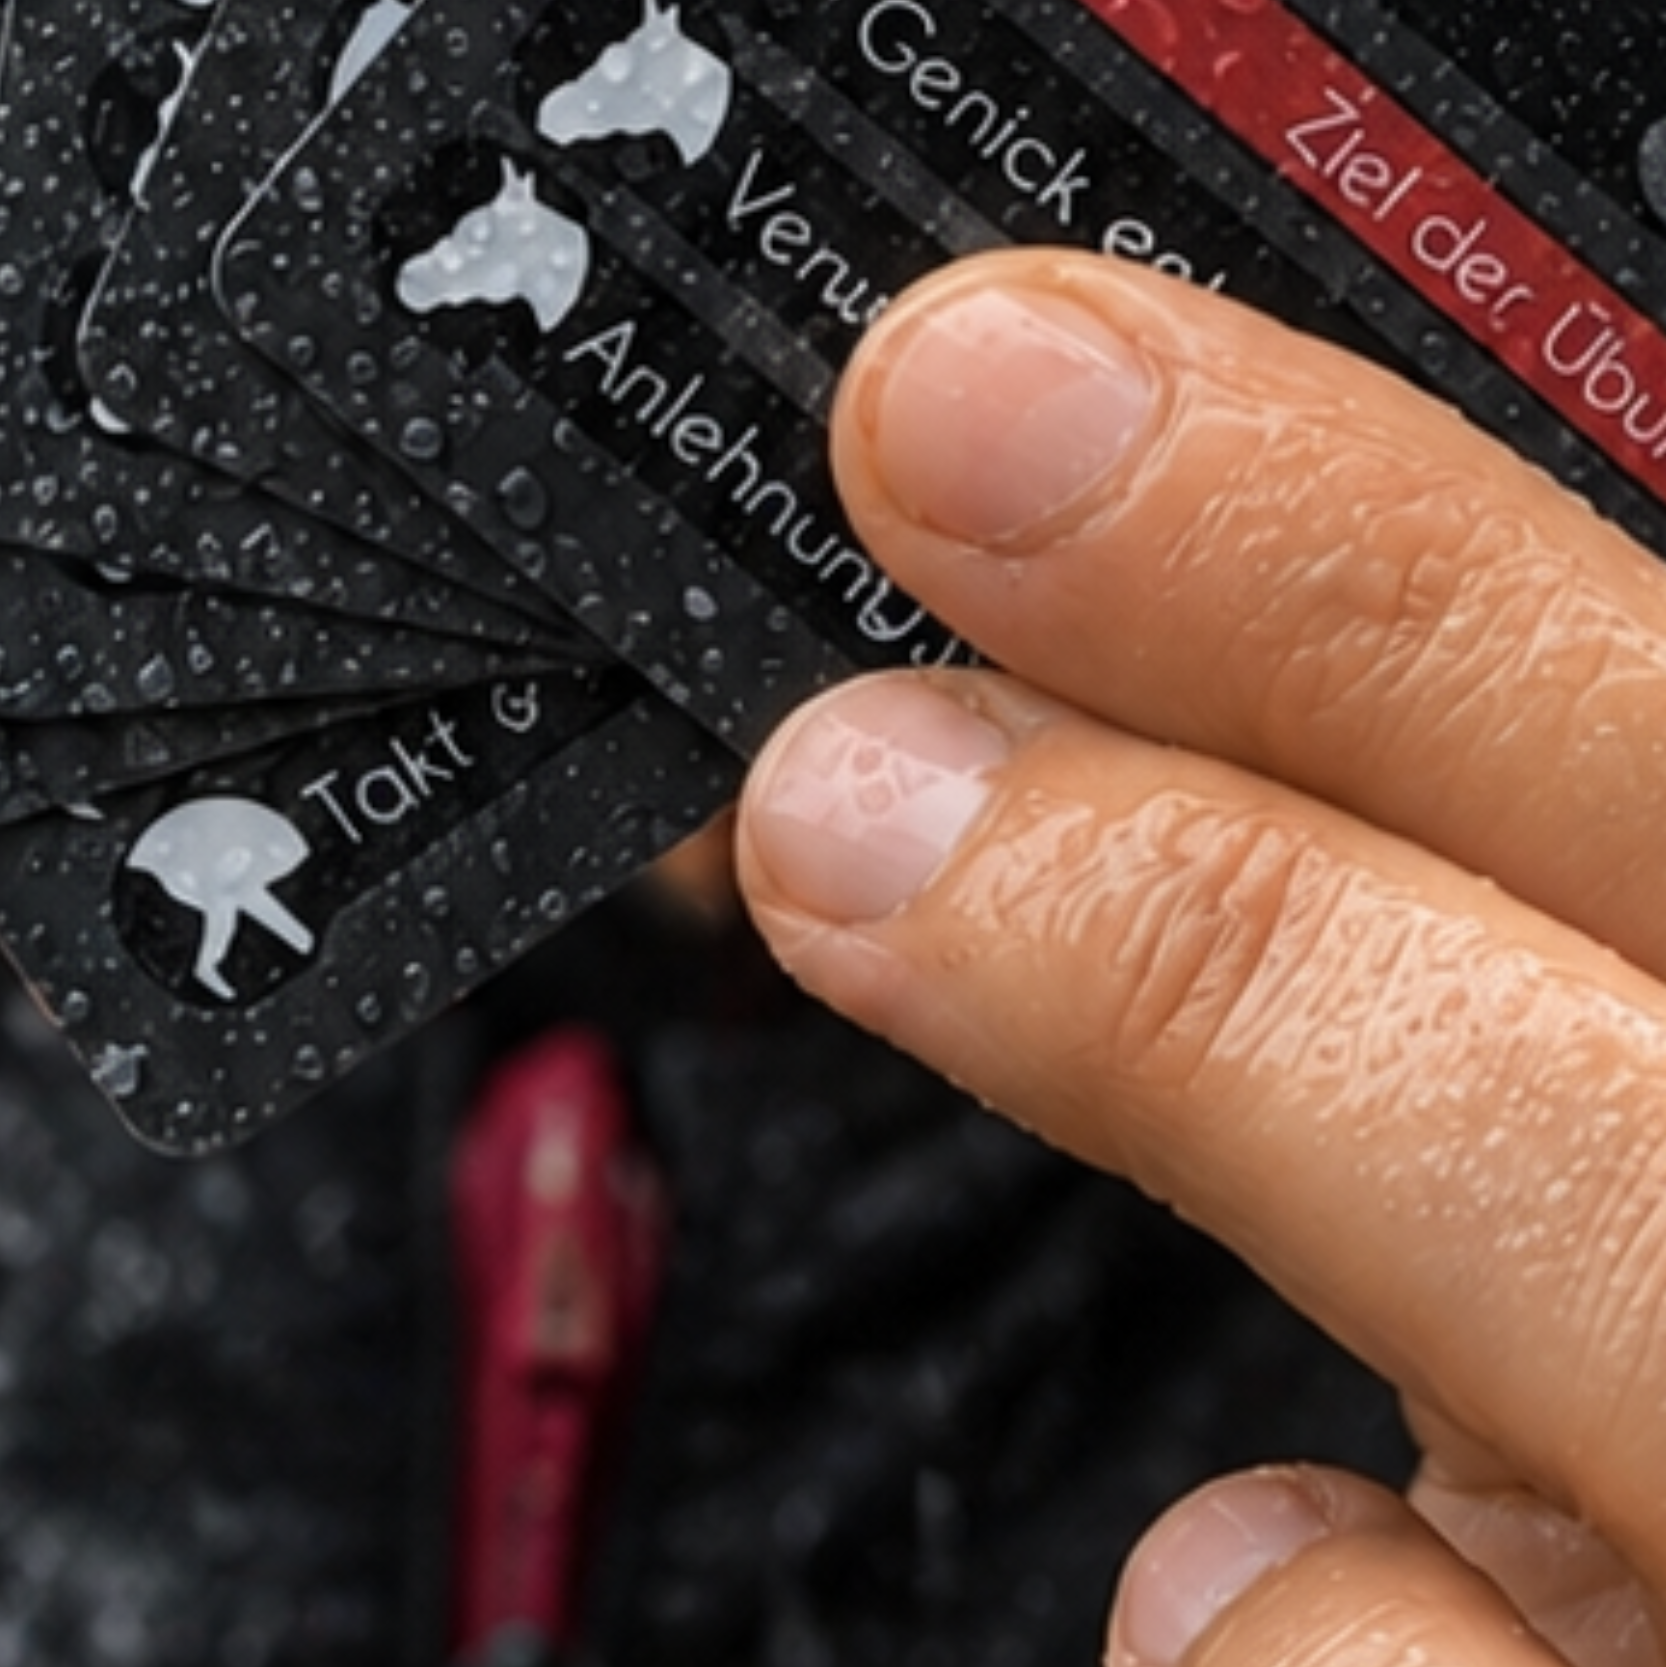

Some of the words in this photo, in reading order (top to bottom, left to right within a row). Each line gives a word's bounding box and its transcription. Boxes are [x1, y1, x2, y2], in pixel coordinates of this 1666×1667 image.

[1285, 87, 1419, 224] Ziel
[1410, 207, 1535, 333] der
[299, 708, 475, 844] Takt
